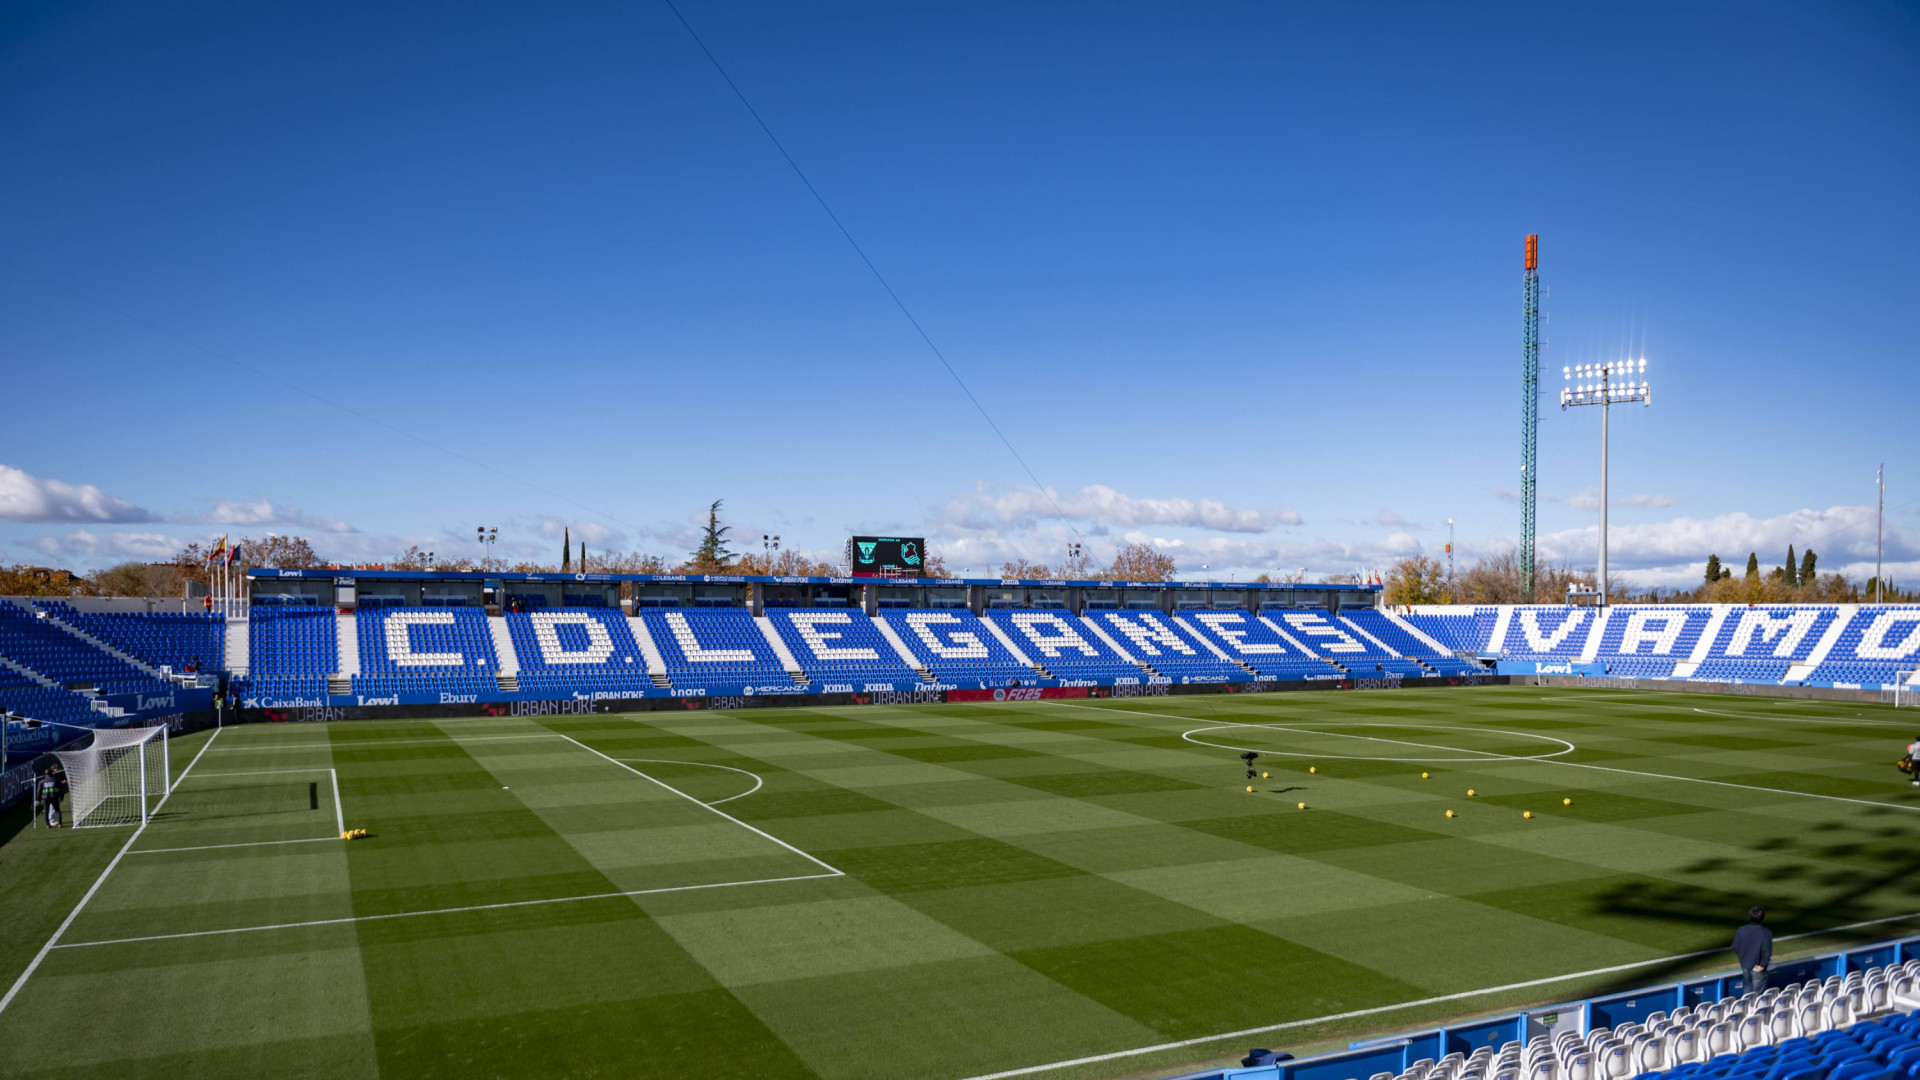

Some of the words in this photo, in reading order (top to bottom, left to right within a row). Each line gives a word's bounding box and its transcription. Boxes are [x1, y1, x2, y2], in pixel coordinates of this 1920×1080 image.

[1536, 663, 1572, 674] Lowi
[1354, 679, 1381, 690] URBAN
[1382, 677, 1401, 689] POKE
[1576, 676, 1611, 689] URBAN
[678, 688, 705, 697] nara
[873, 690, 911, 705] URBAN
[914, 690, 942, 704] POKE
[1111, 685, 1144, 698] URBAN
[1145, 684, 1169, 696] POKE
[136, 691, 175, 711] Lowi
[261, 696, 324, 708] CaixaBank
[357, 694, 399, 706] Lowi
[706, 696, 744, 710] URBAN
[297, 707, 345, 721] URBAN
[510, 700, 558, 717] URBAN
[562, 699, 598, 715] POKE
[6, 729, 49, 745] podoactiva
